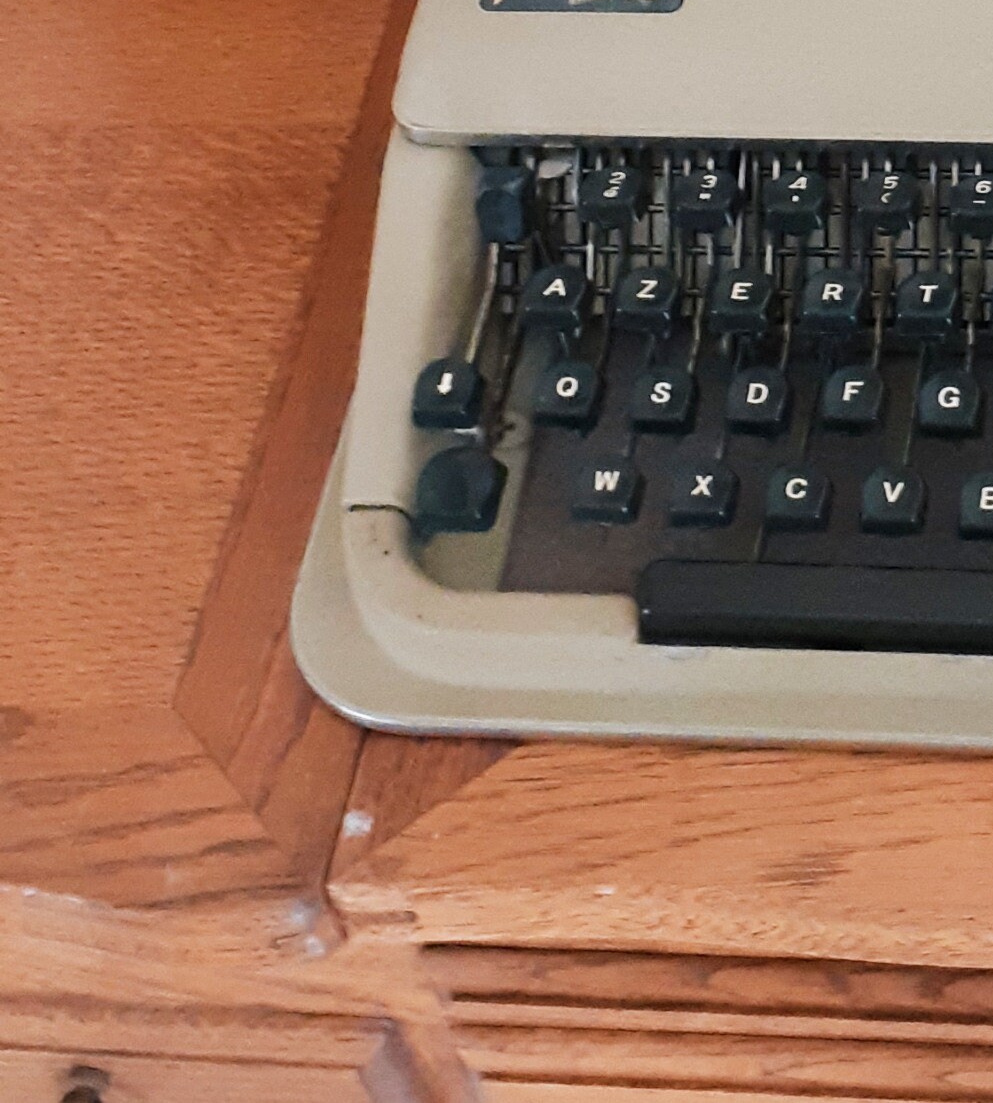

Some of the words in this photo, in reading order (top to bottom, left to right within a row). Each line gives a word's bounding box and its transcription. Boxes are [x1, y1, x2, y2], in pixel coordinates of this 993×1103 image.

[609, 171, 626, 185] 2
[700, 174, 718, 188] 3
[788, 176, 808, 190] 4
[883, 175, 899, 189] 5
[975, 180, 992, 194] 6
[542, 278, 566, 296] A
[636, 279, 658, 299] Z
[730, 282, 754, 300] E
[822, 283, 844, 301] R
[919, 284, 939, 303] T
[650, 381, 672, 404] S
[746, 382, 769, 404] D
[842, 381, 865, 401] F
[937, 386, 960, 408] G
[594, 470, 621, 491] W
[690, 475, 713, 496] X
[785, 477, 808, 499] C
[883, 481, 905, 503] V
